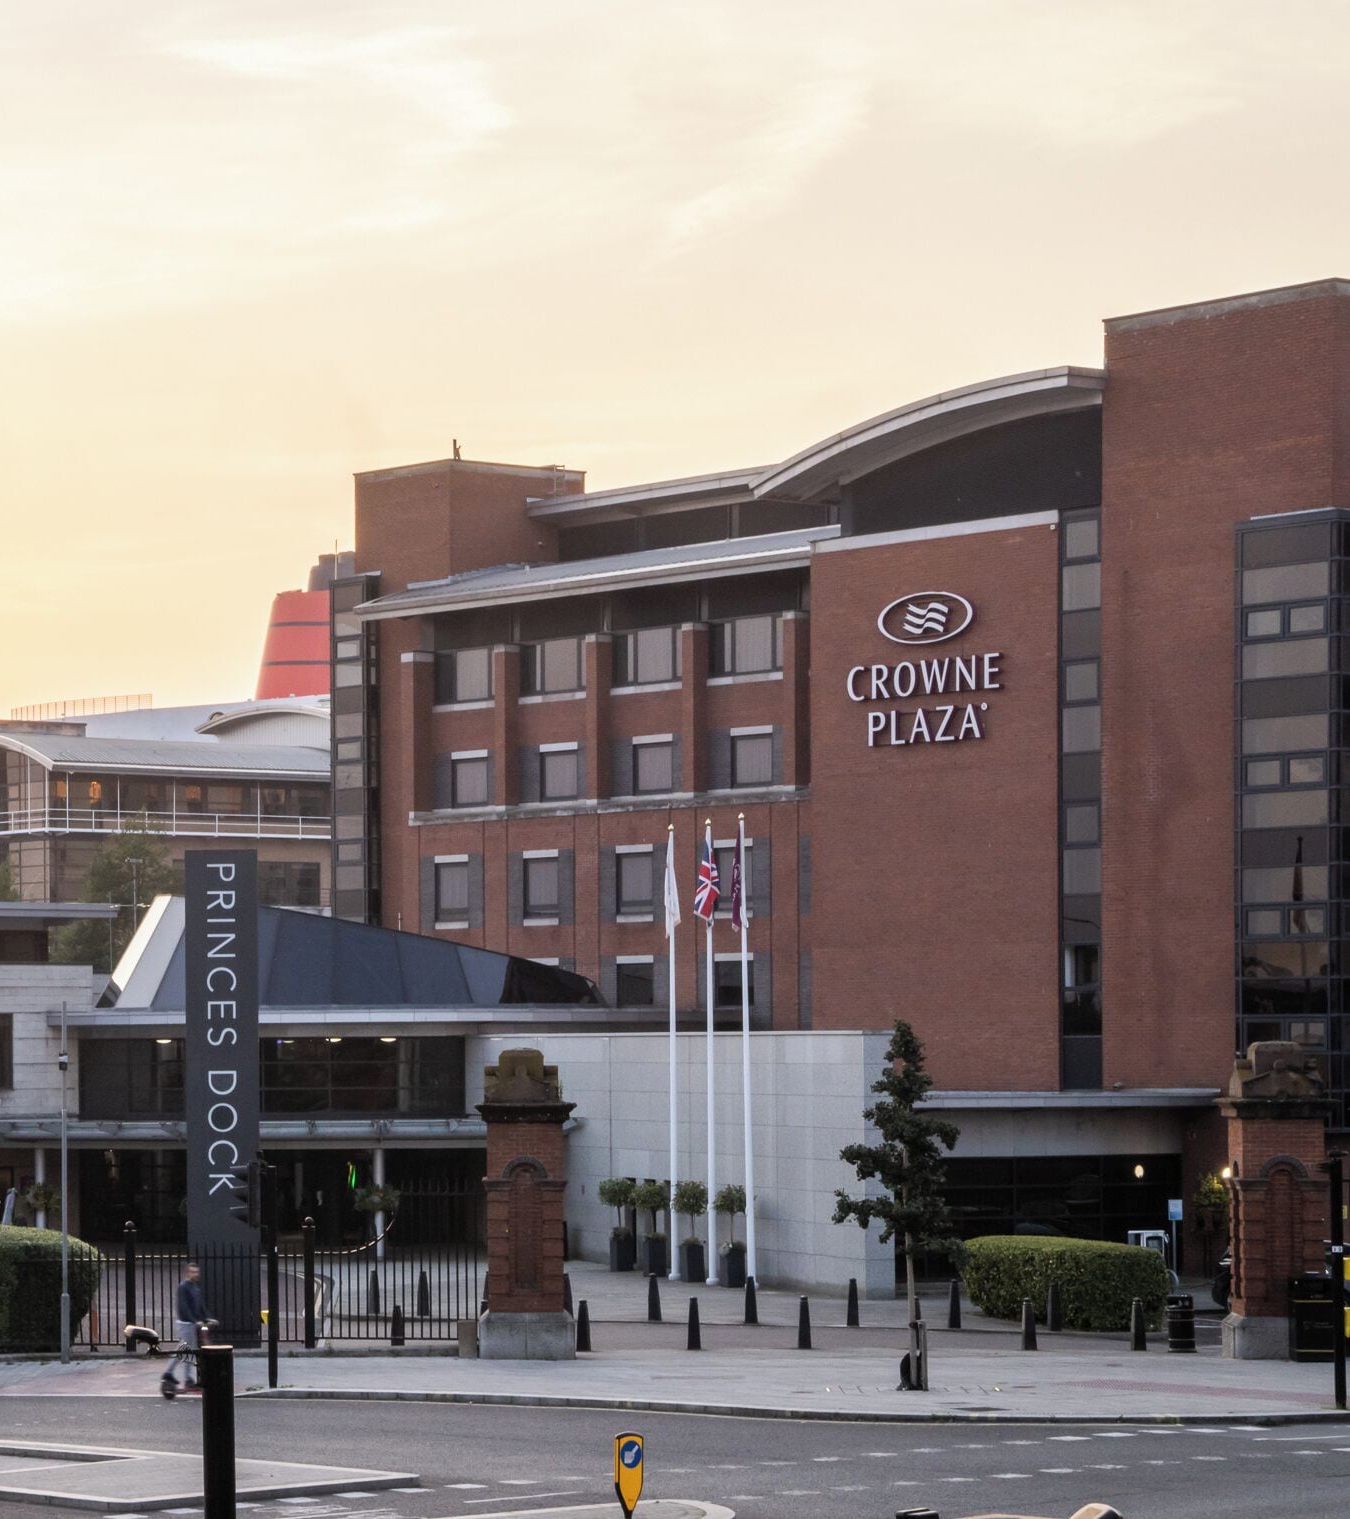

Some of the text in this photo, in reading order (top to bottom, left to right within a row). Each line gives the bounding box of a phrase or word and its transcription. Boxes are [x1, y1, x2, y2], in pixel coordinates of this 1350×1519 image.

[847, 653, 1000, 701] CROWNE
[207, 863, 238, 1196] PRINCES DOCK
